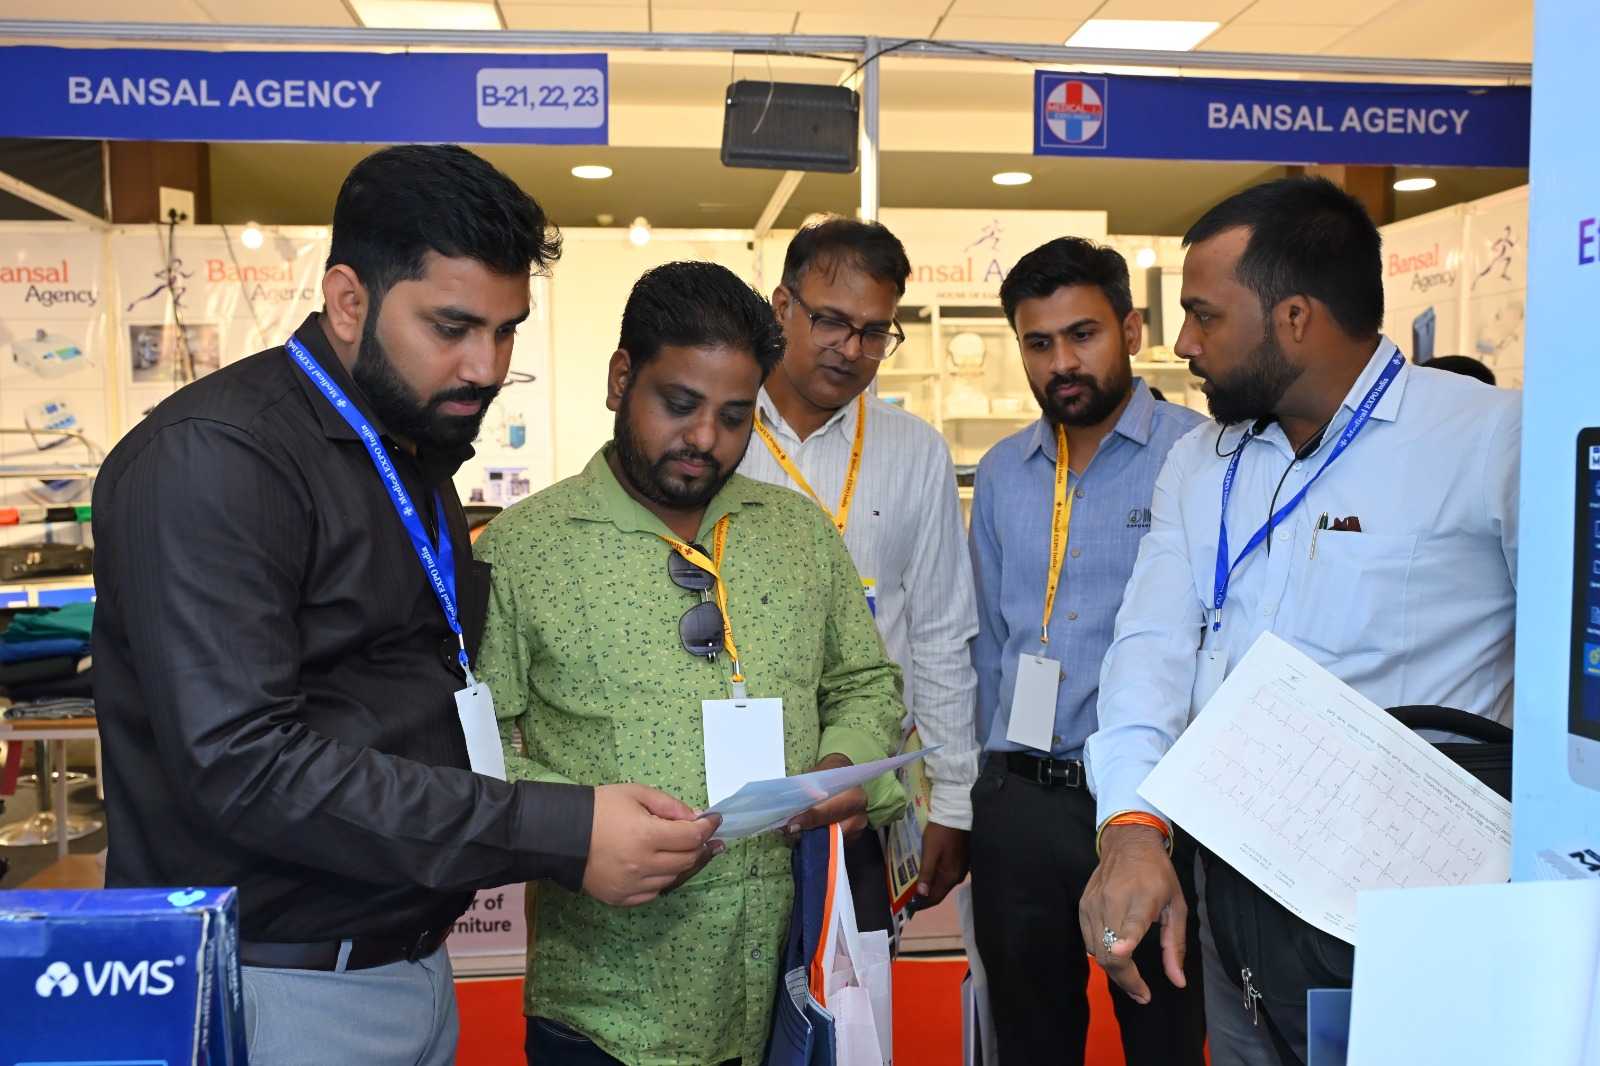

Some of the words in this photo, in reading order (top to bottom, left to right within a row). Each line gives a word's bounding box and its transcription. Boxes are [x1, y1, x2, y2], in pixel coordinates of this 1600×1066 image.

[68, 76, 221, 106] BANSAL
[228, 79, 382, 108] AGENCY
[482, 85, 535, 111] B-21,
[538, 85, 569, 111] 22,
[572, 85, 599, 107] 23
[1208, 102, 1334, 132] BANSAL
[1340, 107, 1470, 135] AGENCY
[1578, 217, 1600, 266] E
[0, 259, 68, 284] ansal
[207, 258, 295, 283] Bansal
[907, 256, 974, 284] nsal
[1388, 242, 1440, 277] Bansal
[1410, 271, 1457, 293] Agency
[25, 284, 97, 308] Agency
[294, 349, 315, 371] EXPO
[311, 368, 338, 399] Medical
[1345, 407, 1368, 439] Medical
[1363, 389, 1379, 410] EXPO
[1375, 376, 1388, 393] India
[359, 423, 377, 447] India
[373, 446, 390, 472] EXPO
[386, 471, 408, 505] Medical
[419, 545, 434, 569] India
[429, 567, 446, 593] EXPO
[484, 894, 503, 910] of
[450, 917, 512, 933] rniture
[83, 960, 175, 997] VMS
